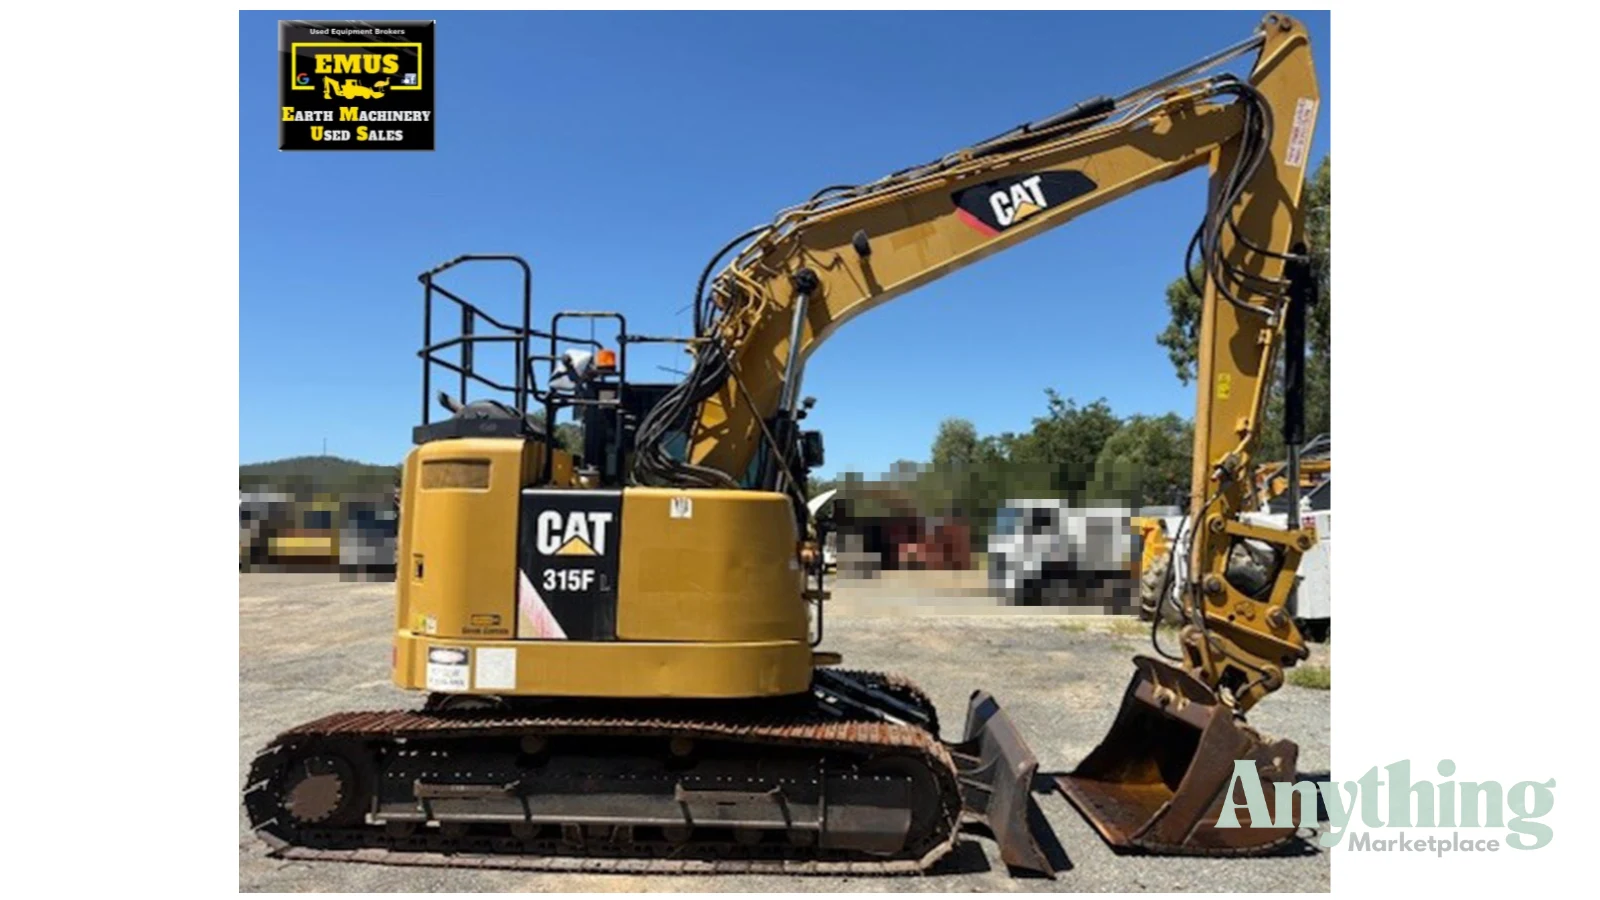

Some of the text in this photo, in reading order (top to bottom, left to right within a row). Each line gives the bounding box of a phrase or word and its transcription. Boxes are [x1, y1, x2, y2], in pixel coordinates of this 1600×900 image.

[988, 175, 1048, 226] CAT
[536, 510, 613, 555] CAT
[543, 568, 595, 591] 315F
